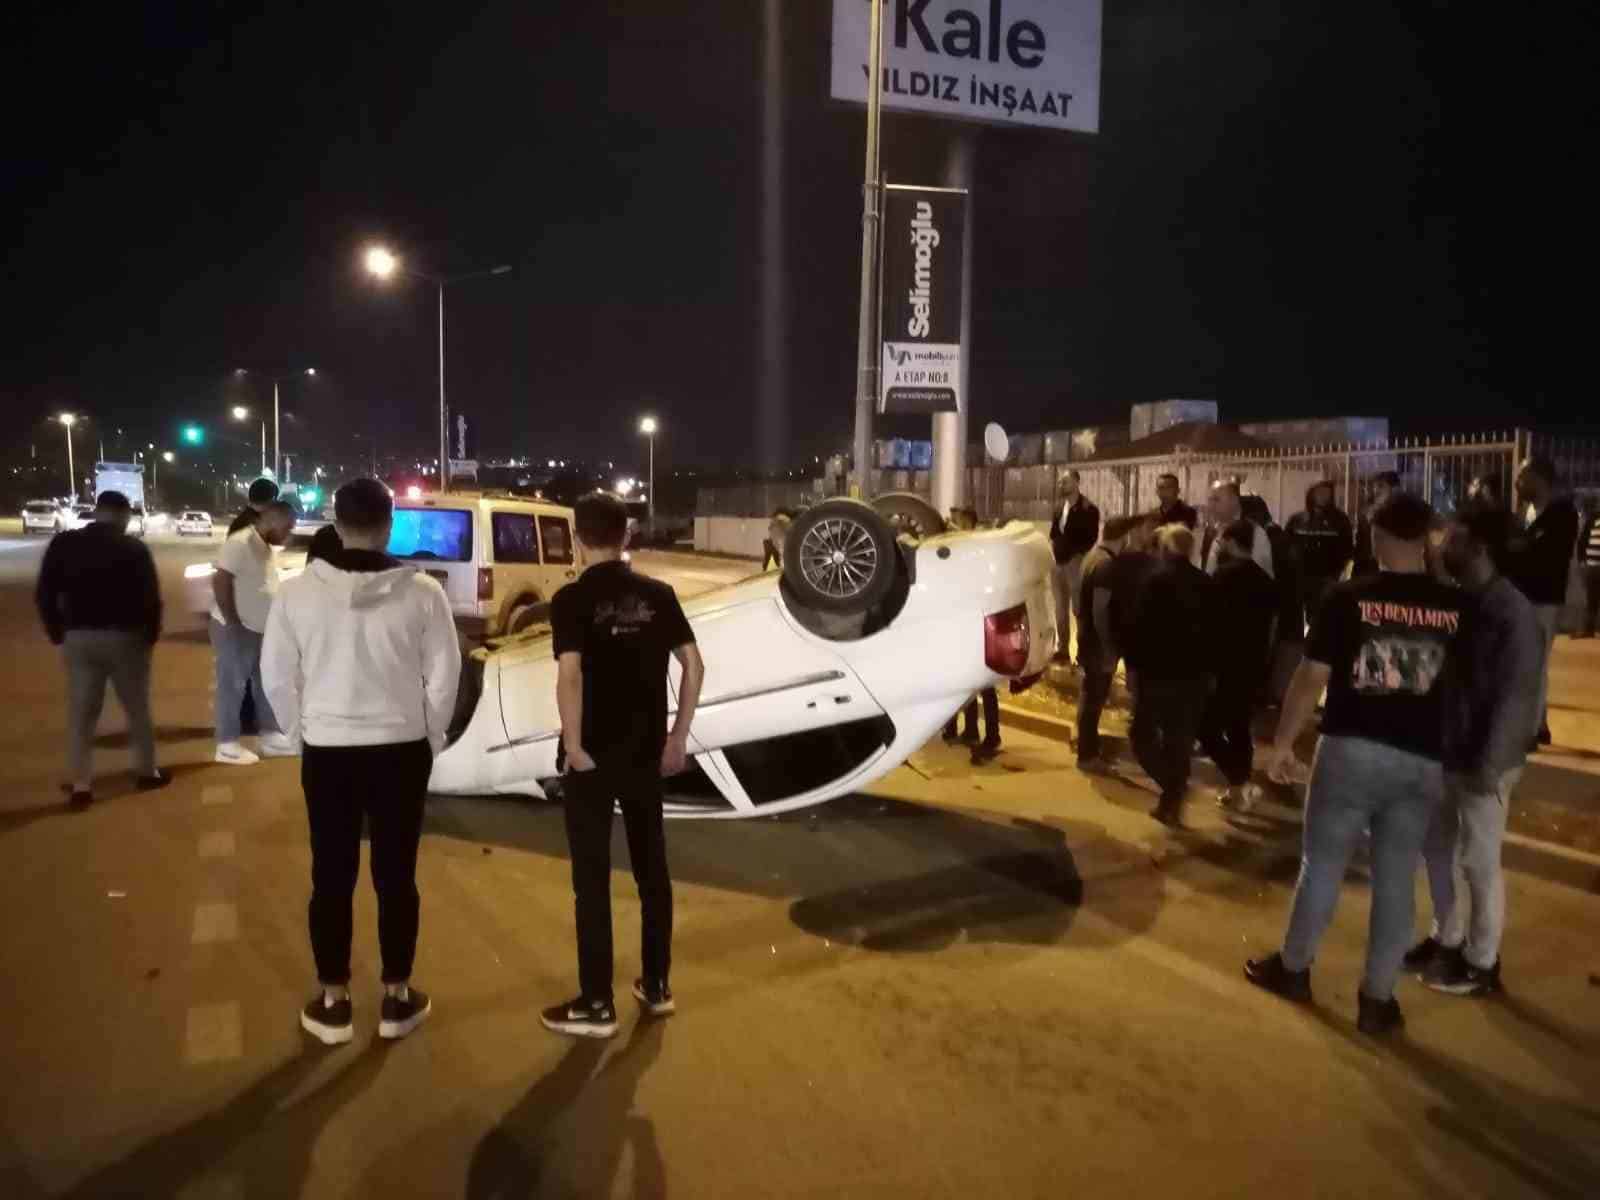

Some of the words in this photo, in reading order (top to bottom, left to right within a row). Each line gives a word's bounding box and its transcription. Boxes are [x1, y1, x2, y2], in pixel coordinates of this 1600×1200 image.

[893, 0, 1046, 69] Kale
[969, 74, 1073, 118] İNŞAAT
[908, 201, 940, 338] Selimoğlu
[904, 371, 927, 384] ETAP
